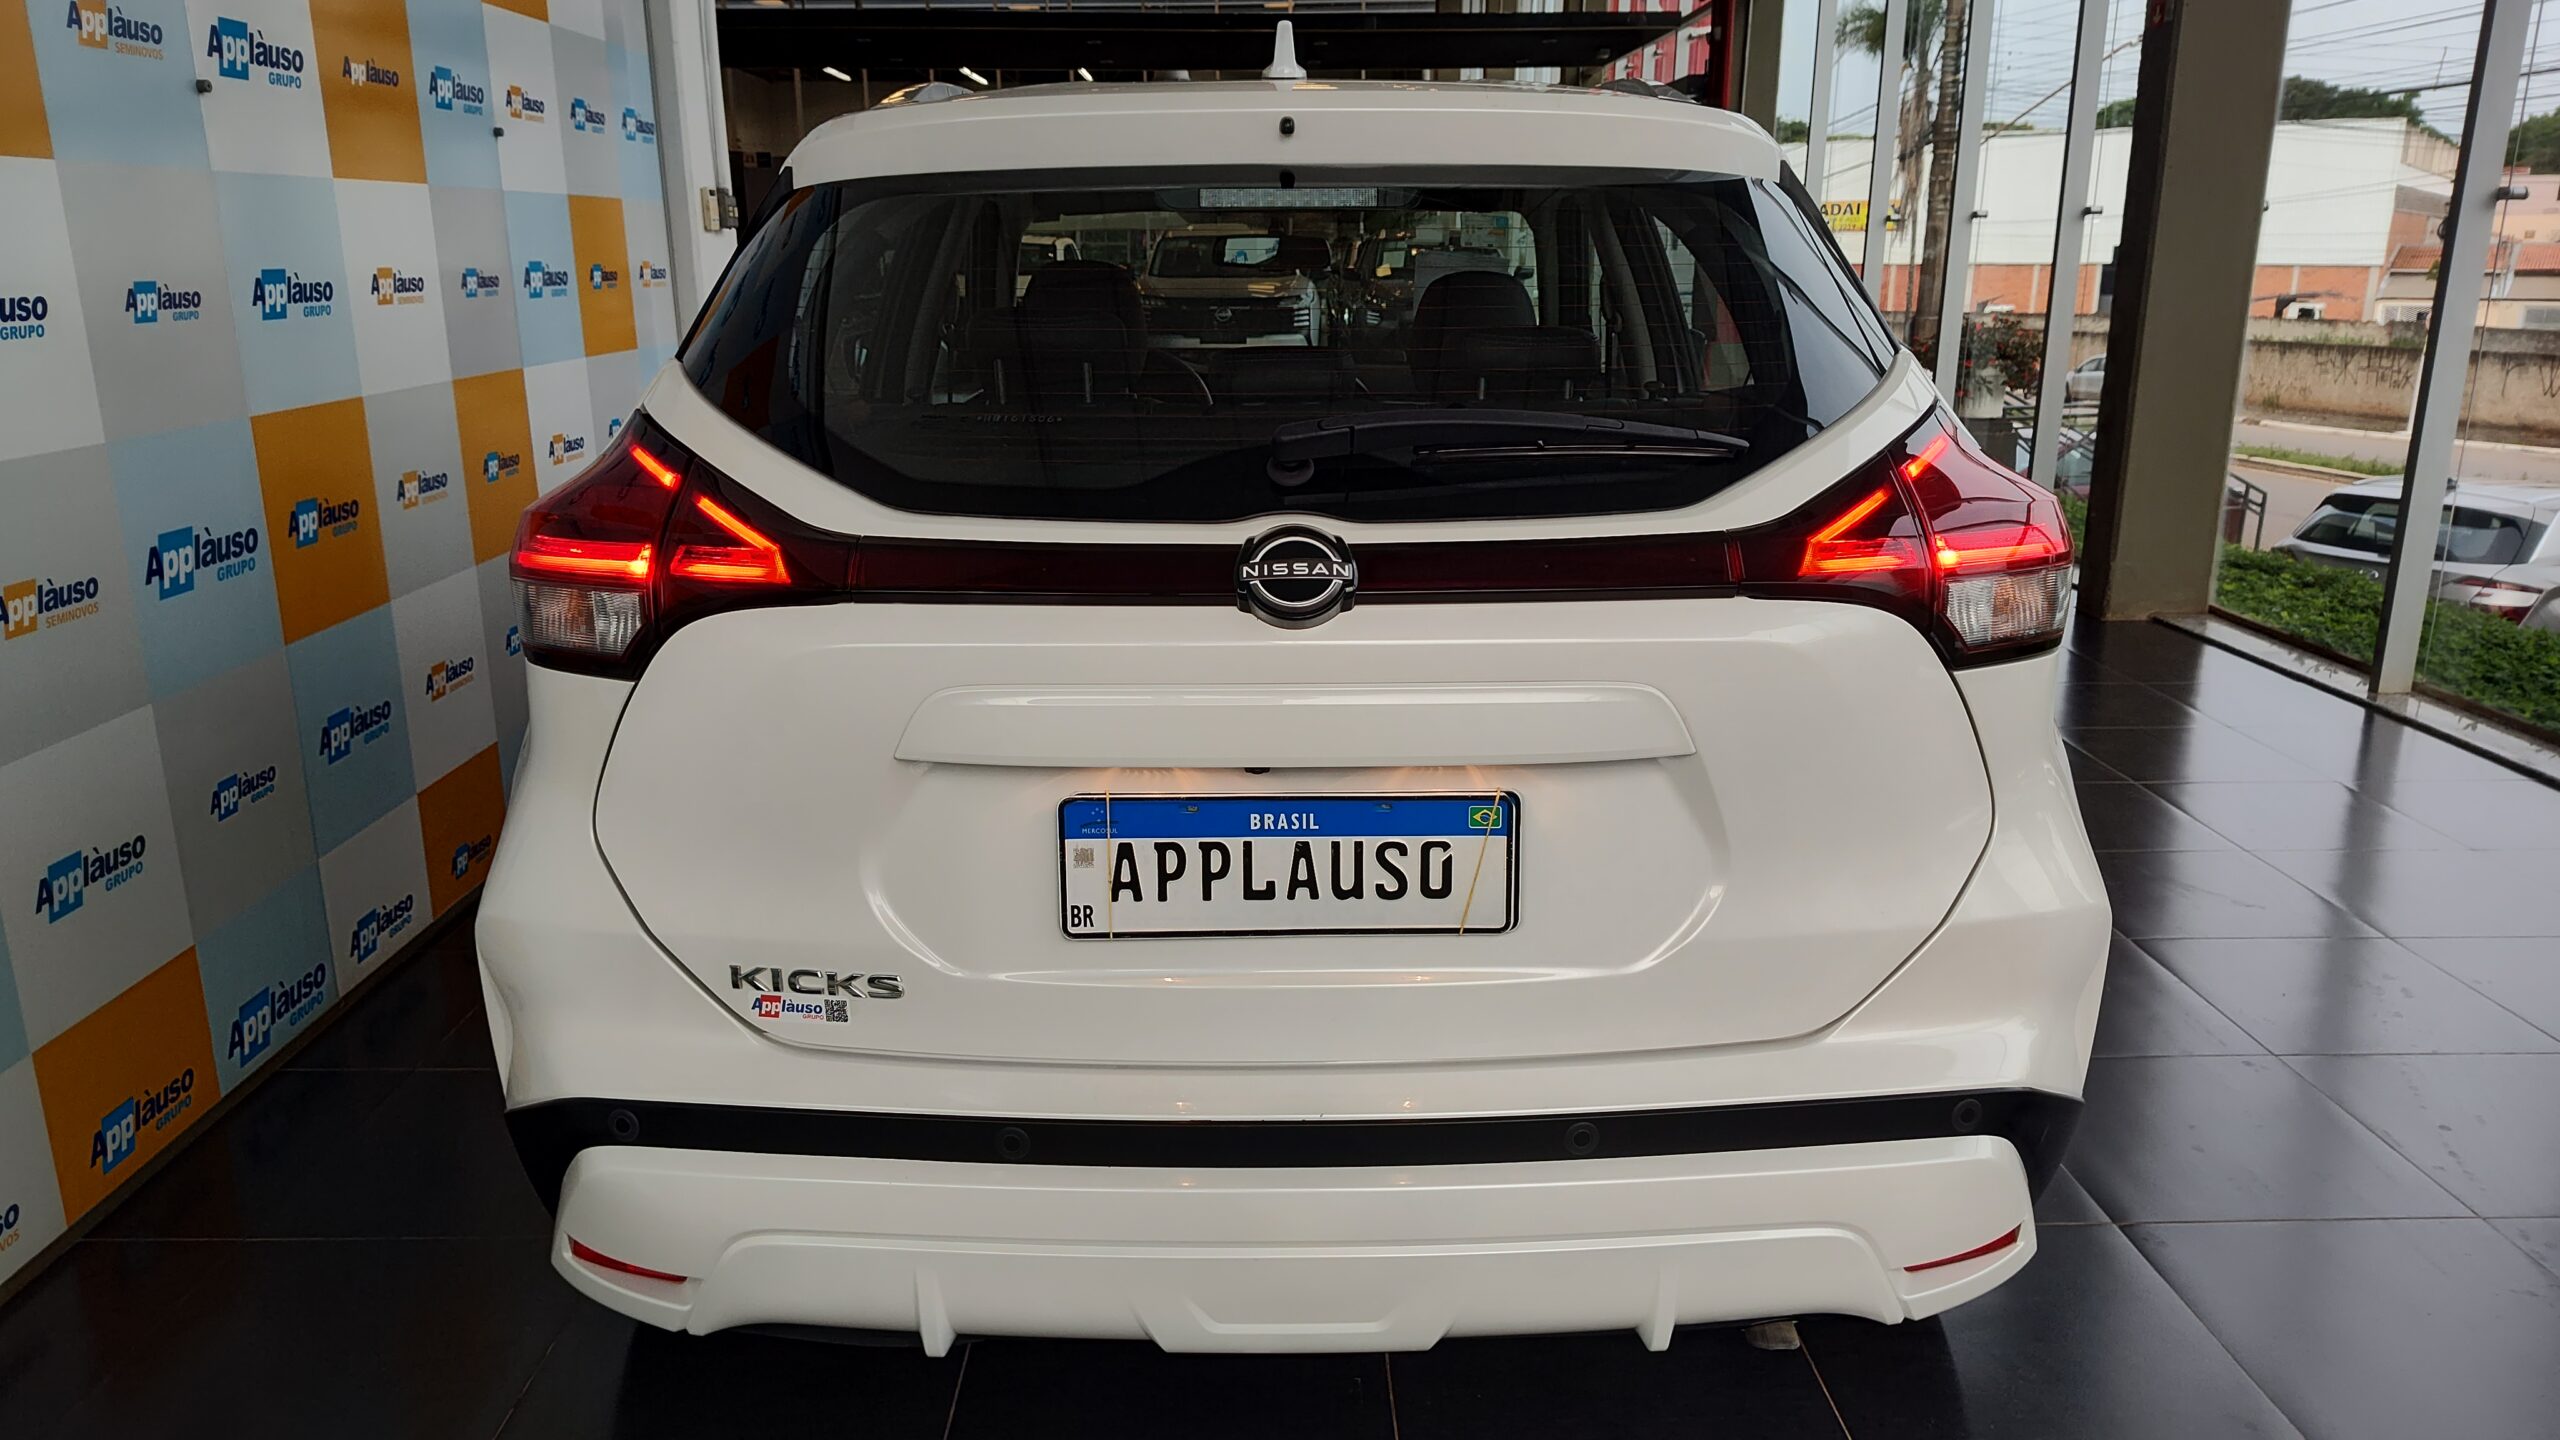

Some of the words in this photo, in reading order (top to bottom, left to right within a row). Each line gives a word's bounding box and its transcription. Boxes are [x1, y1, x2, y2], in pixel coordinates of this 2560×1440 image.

[66, 0, 163, 45] Applàuso
[114, 42, 165, 61] SEMINOVOS
[207, 24, 304, 74] Applàuso
[268, 71, 302, 89] GRUPO
[342, 55, 399, 87] Applàuso
[429, 71, 484, 105] Applàuso
[125, 283, 202, 318] Applàuso
[252, 272, 334, 314] Applàuso
[371, 269, 424, 300] Applàuso
[172, 310, 200, 322] GRUPO
[303, 303, 332, 318] GRUPO
[0, 324, 45, 341] GRUPO
[396, 469, 448, 504] Applàuso
[288, 497, 360, 542] Applàuso
[145, 526, 259, 590] Applàuso
[216, 556, 257, 582] GRUPO
[1242, 562, 1349, 578] NISSAN
[45, 601, 99, 629] SEMINOVOS
[425, 656, 474, 697] Applàuso
[319, 699, 392, 757] Applàuso
[210, 765, 276, 816] Applàuso
[251, 783, 275, 804] GRUPO
[1250, 812, 1320, 831] BRASIL
[35, 834, 146, 915] Applàuso
[105, 860, 144, 892] GRUPO
[350, 893, 414, 959] Applàuso
[1070, 904, 1095, 928] BR
[729, 964, 905, 1000] KICKS
[227, 962, 326, 1061] Applàuso
[289, 989, 324, 1027] GRUPO
[751, 997, 823, 1016] Applàuso
[90, 1066, 195, 1169] Applàuso
